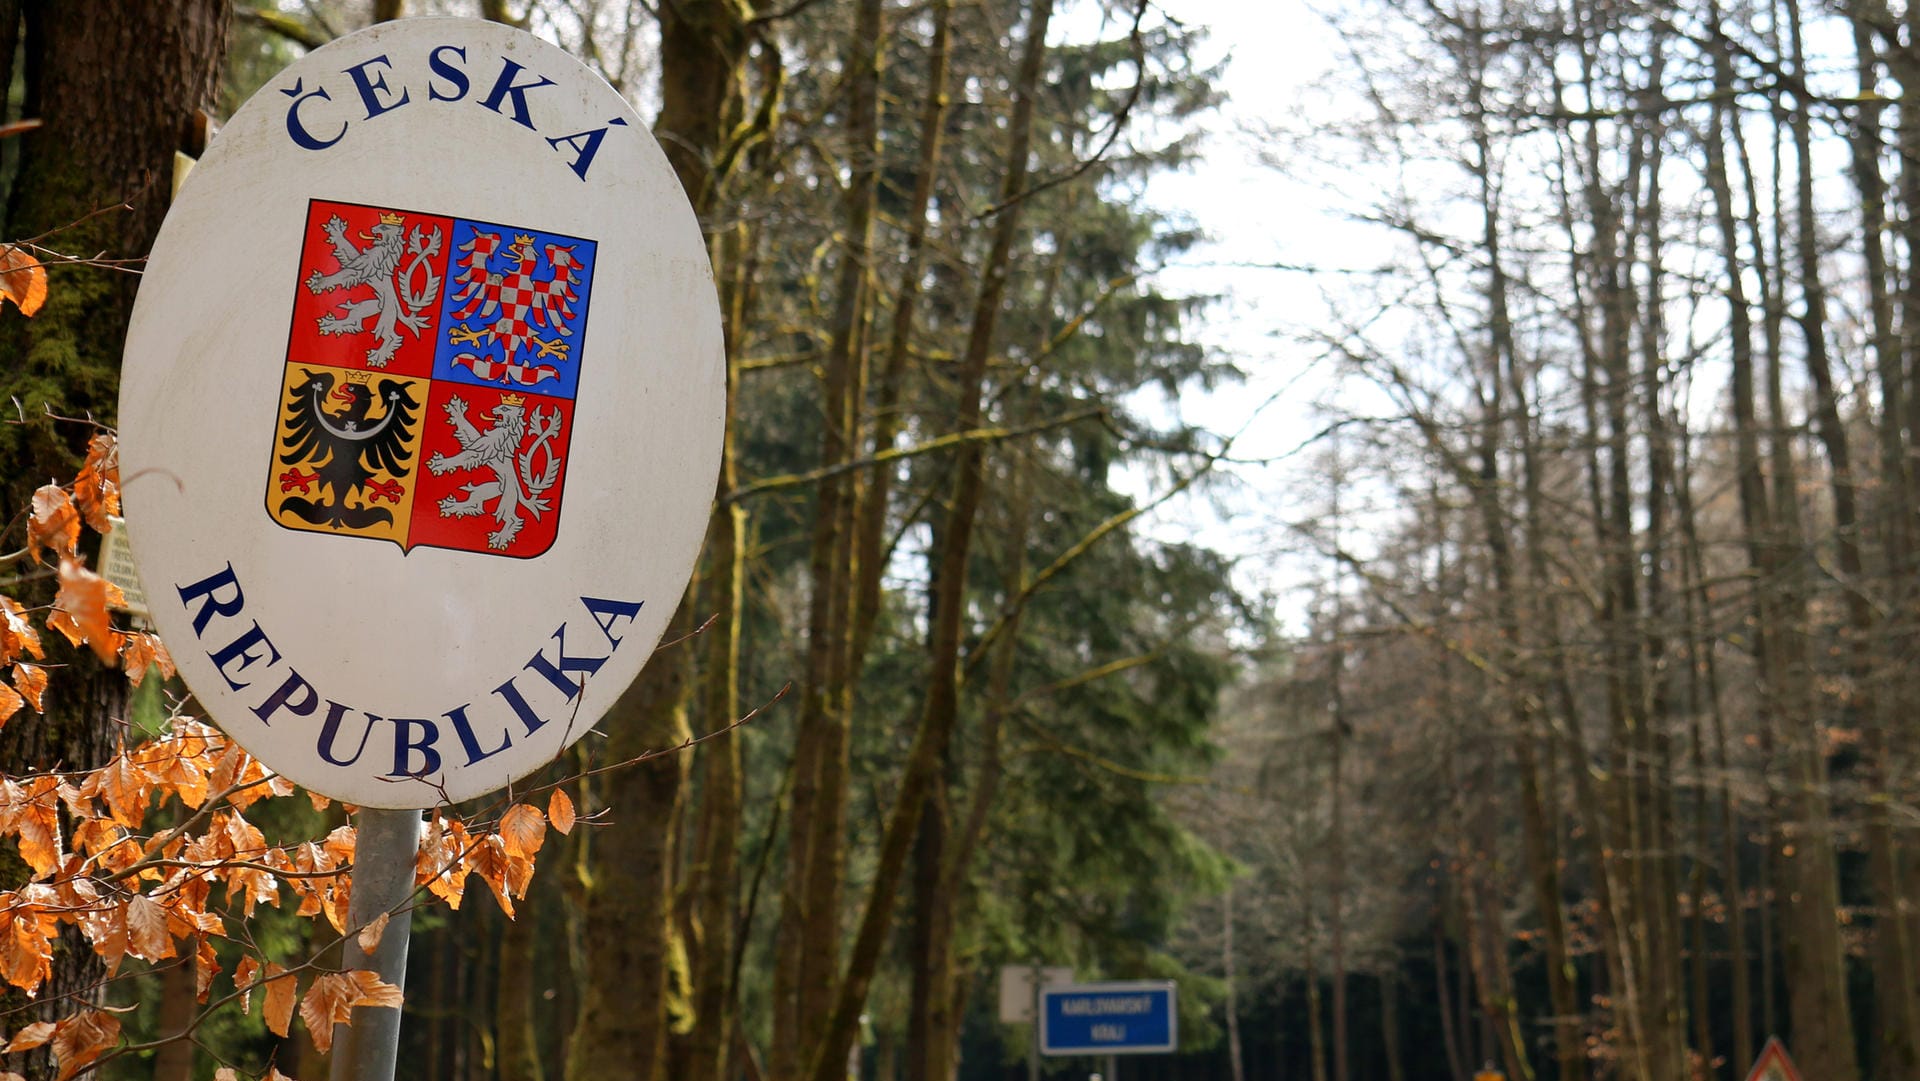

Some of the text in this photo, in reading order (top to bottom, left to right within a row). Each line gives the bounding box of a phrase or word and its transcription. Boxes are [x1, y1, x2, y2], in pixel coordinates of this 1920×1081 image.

[280, 45, 628, 183] ČESKÁ
[176, 560, 645, 777] REPUBLIKA
[1090, 1023, 1127, 1041] KRAJ
